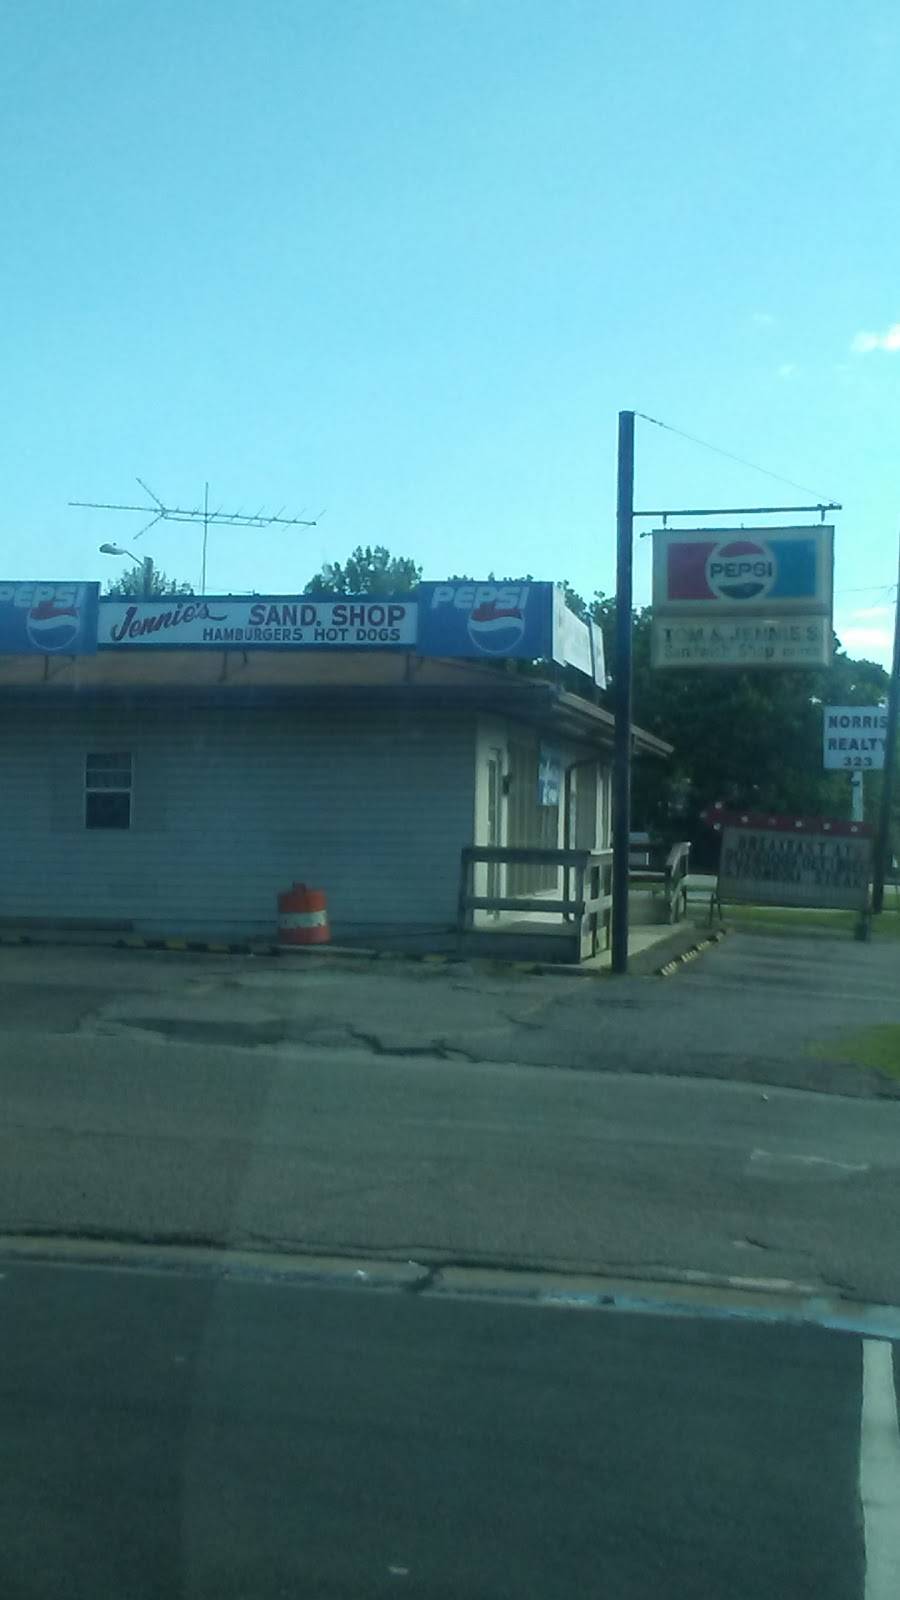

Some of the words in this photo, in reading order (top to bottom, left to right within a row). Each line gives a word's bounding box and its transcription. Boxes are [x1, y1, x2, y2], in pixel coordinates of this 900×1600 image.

[710, 562, 773, 578] PEPSI
[432, 586, 530, 608] PEPSI
[111, 602, 228, 641] Jennie's
[249, 604, 321, 627] SAND.
[331, 604, 405, 627] SHOP
[203, 628, 303, 641] HAMBURGERS
[314, 628, 349, 641] HOT
[356, 628, 400, 642] DOGS
[828, 715, 888, 729] NORRIS
[843, 756, 872, 767] 323
